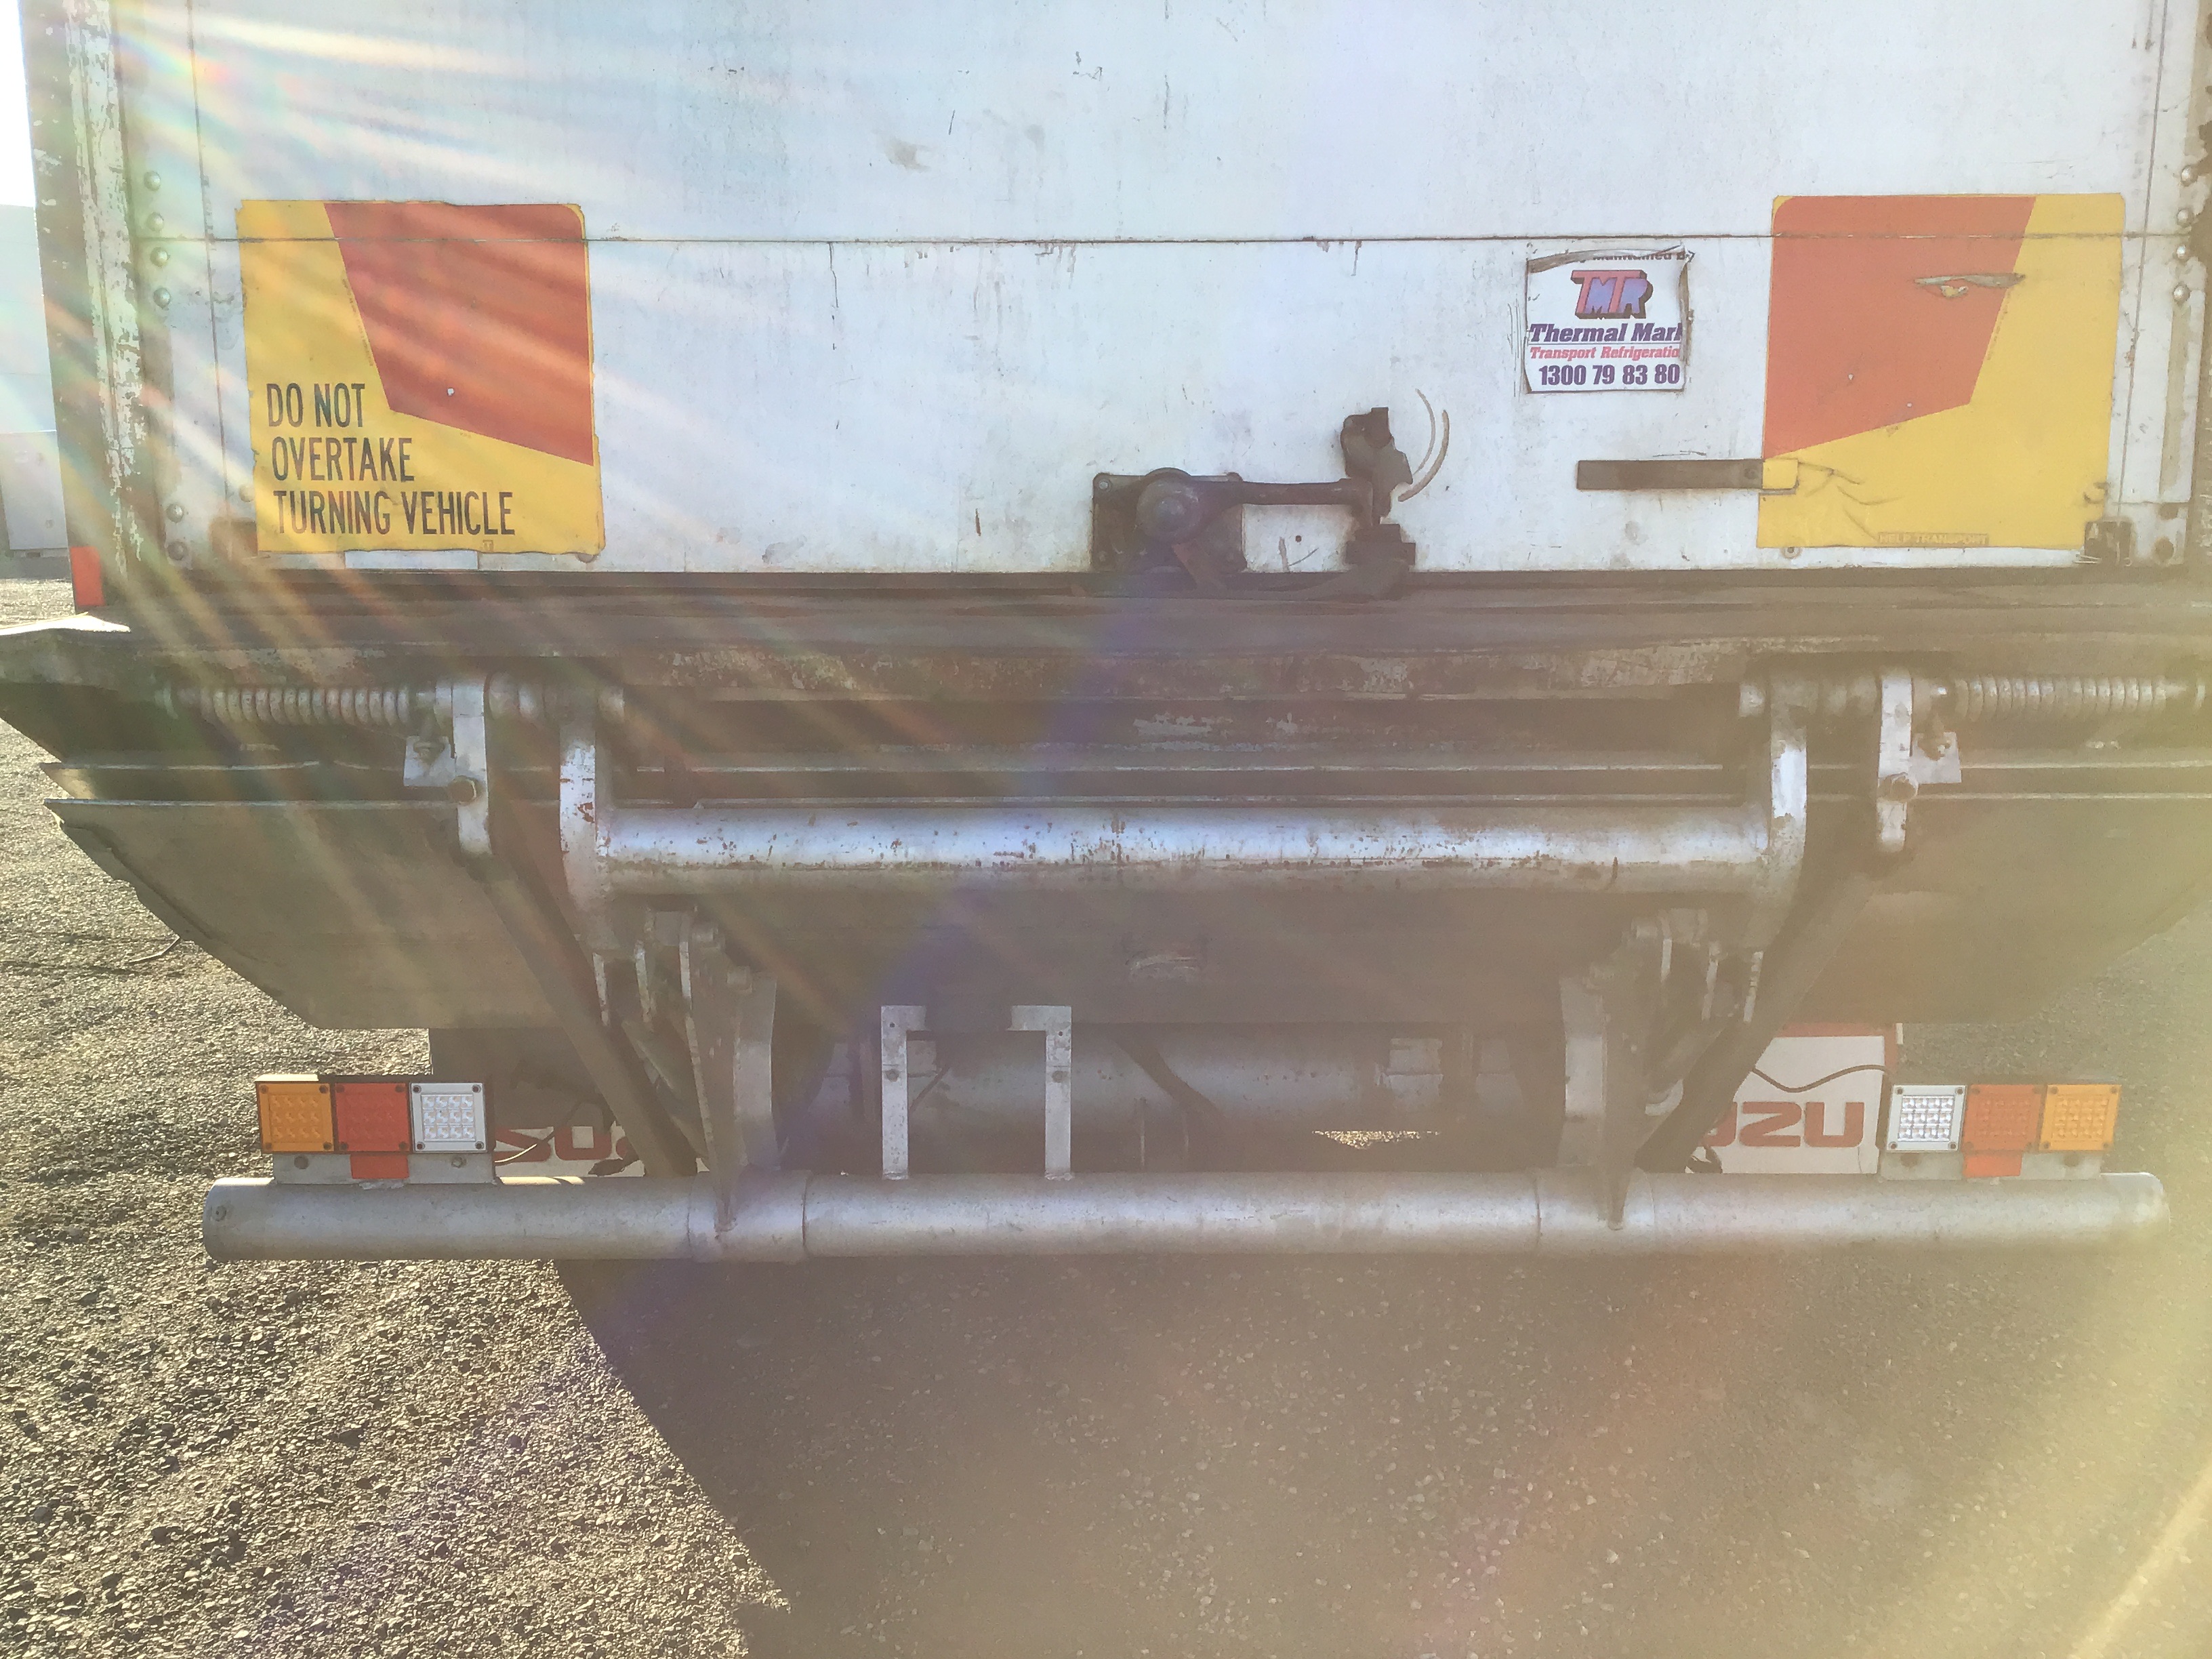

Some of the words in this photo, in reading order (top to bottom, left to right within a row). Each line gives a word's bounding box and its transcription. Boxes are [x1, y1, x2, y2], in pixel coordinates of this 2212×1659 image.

[1529, 323, 1628, 342] Thermal
[1530, 346, 1597, 361] Transport
[1600, 346, 1680, 361] Refrigeratio
[1538, 365, 1586, 386] 1300
[1593, 365, 1616, 384] 79
[1622, 365, 1647, 385] 83
[1654, 364, 1680, 384] 80
[266, 383, 304, 428] DO
[314, 383, 366, 428] NOT
[272, 436, 415, 483] OVERTAKE
[273, 490, 391, 535] TURNING
[401, 491, 516, 536] VEHICLE
